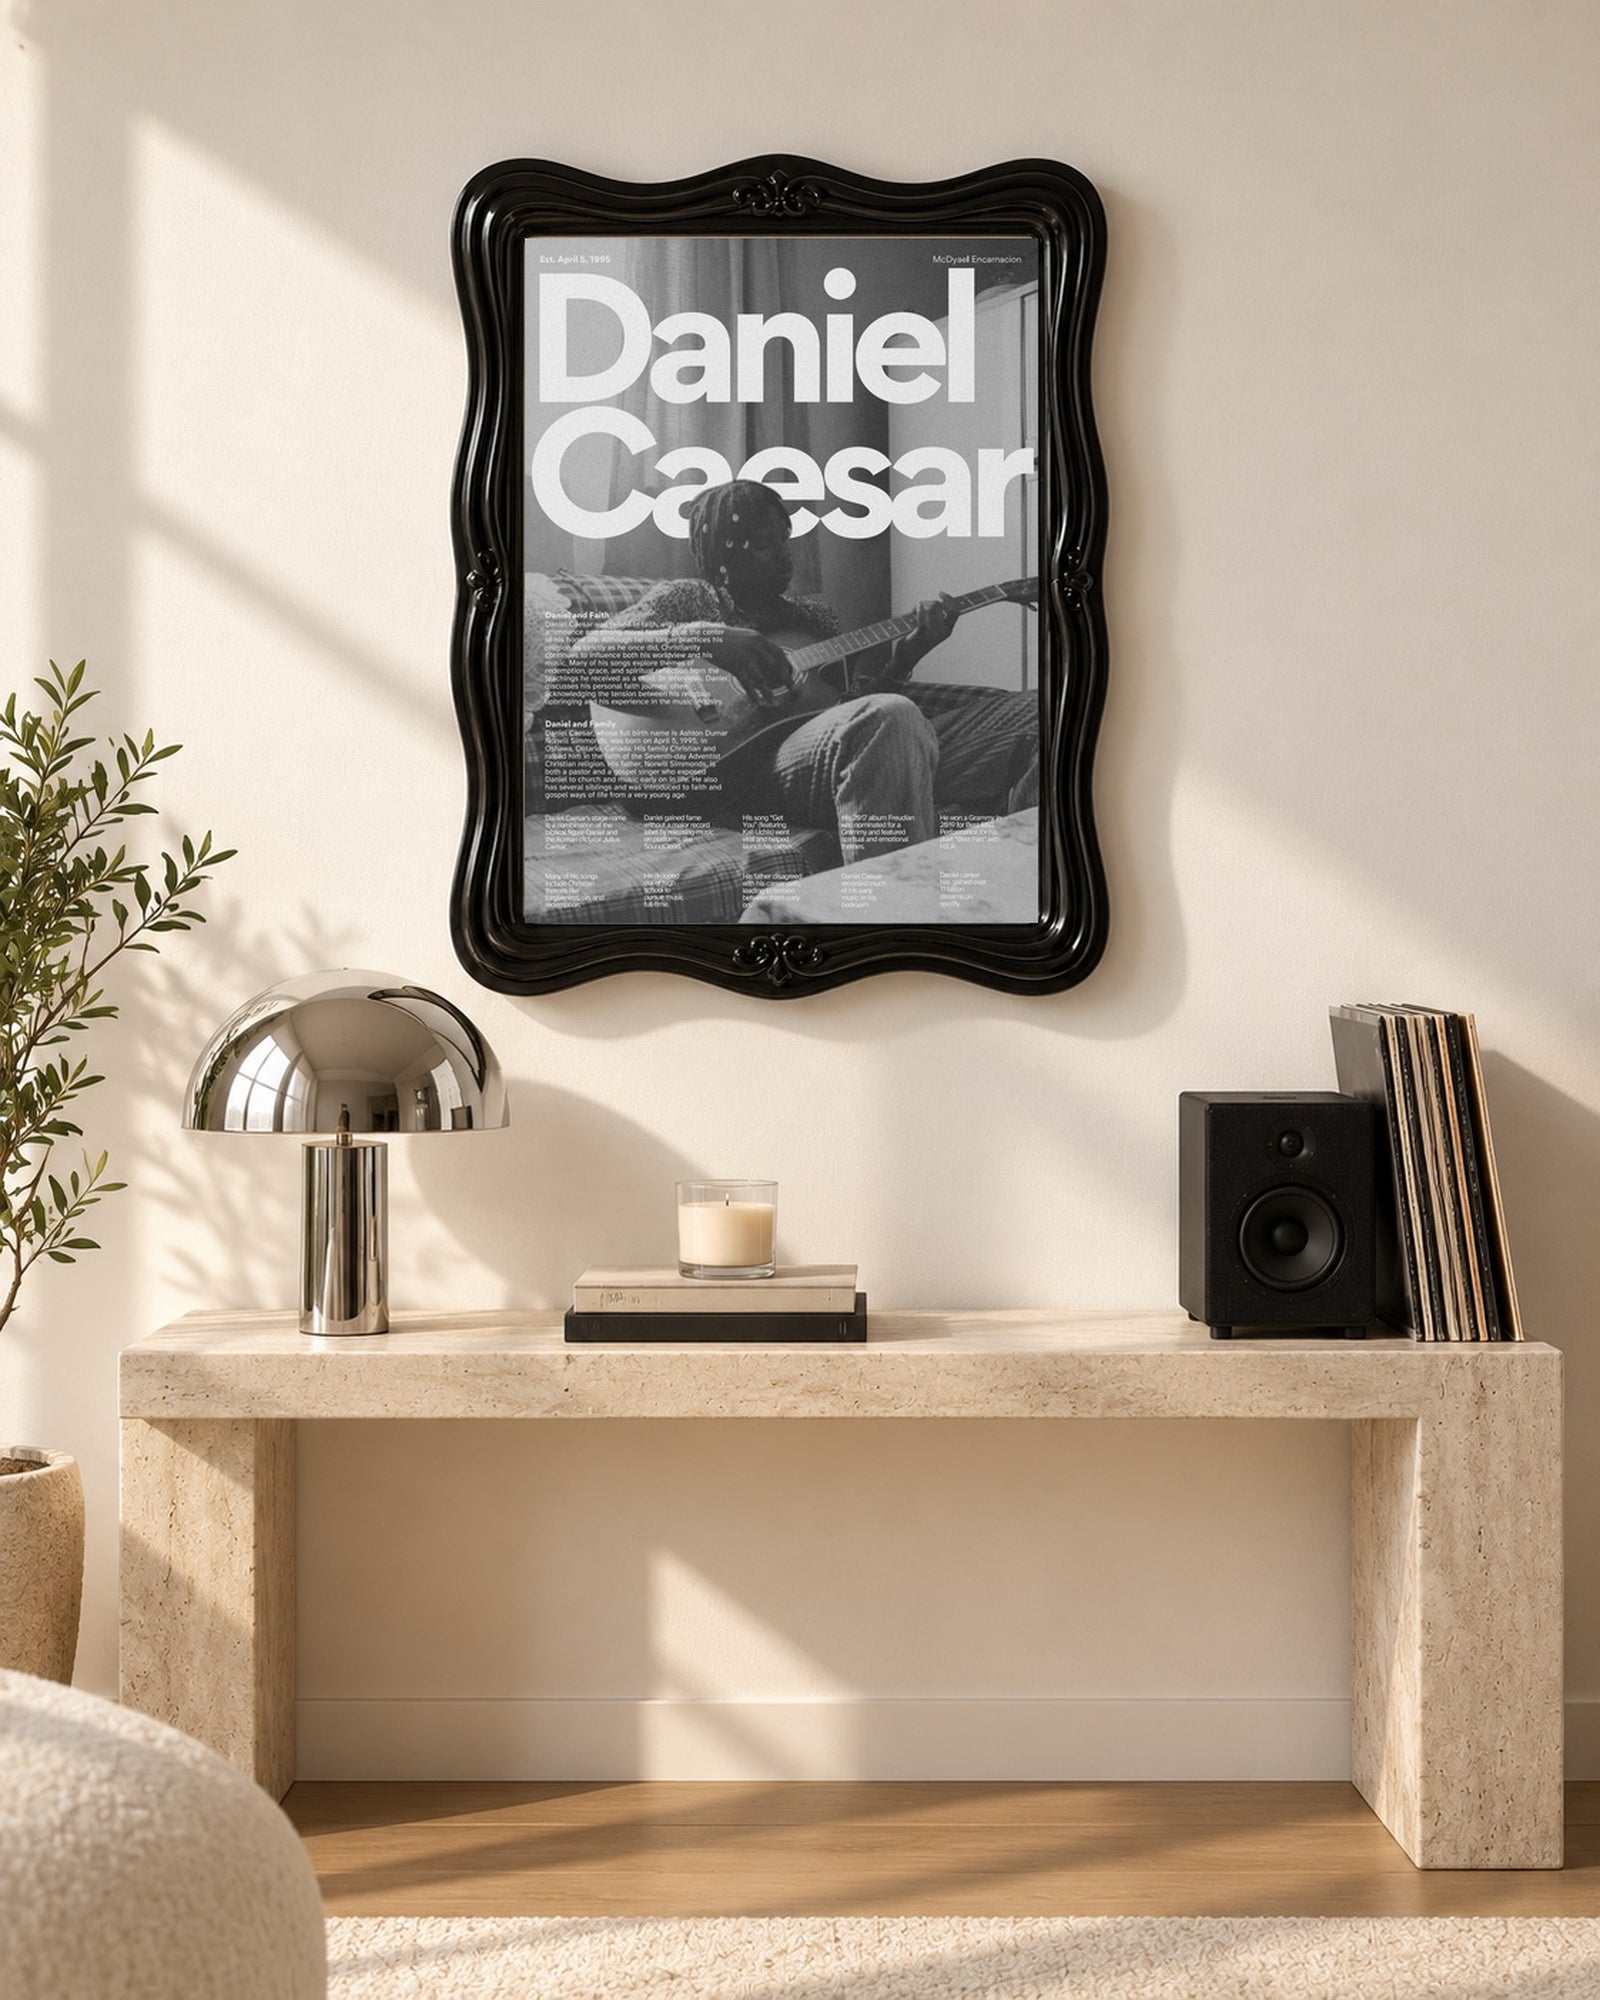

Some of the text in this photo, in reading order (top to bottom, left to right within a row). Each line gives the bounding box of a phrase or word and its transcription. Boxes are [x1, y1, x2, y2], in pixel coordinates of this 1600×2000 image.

[540, 255, 612, 265] Est. April 5, 1995
[971, 254, 1023, 264] Encarnacion
[539, 267, 975, 403] Daniel
[531, 405, 1034, 538] Caesar
[661, 645, 700, 653] Christianity
[569, 660, 587, 668] Many
[632, 660, 658, 668] explore
[593, 683, 622, 691] personal
[611, 699, 649, 707] experience
[545, 720, 616, 729] Daniel and Family
[653, 737, 670, 746] April
[647, 745, 669, 754] family
[644, 753, 687, 761] Seventh-day
[569, 769, 592, 777] pastor
[640, 776, 657, 784] early
[585, 784, 612, 792] siblings
[545, 792, 568, 800] gospel
